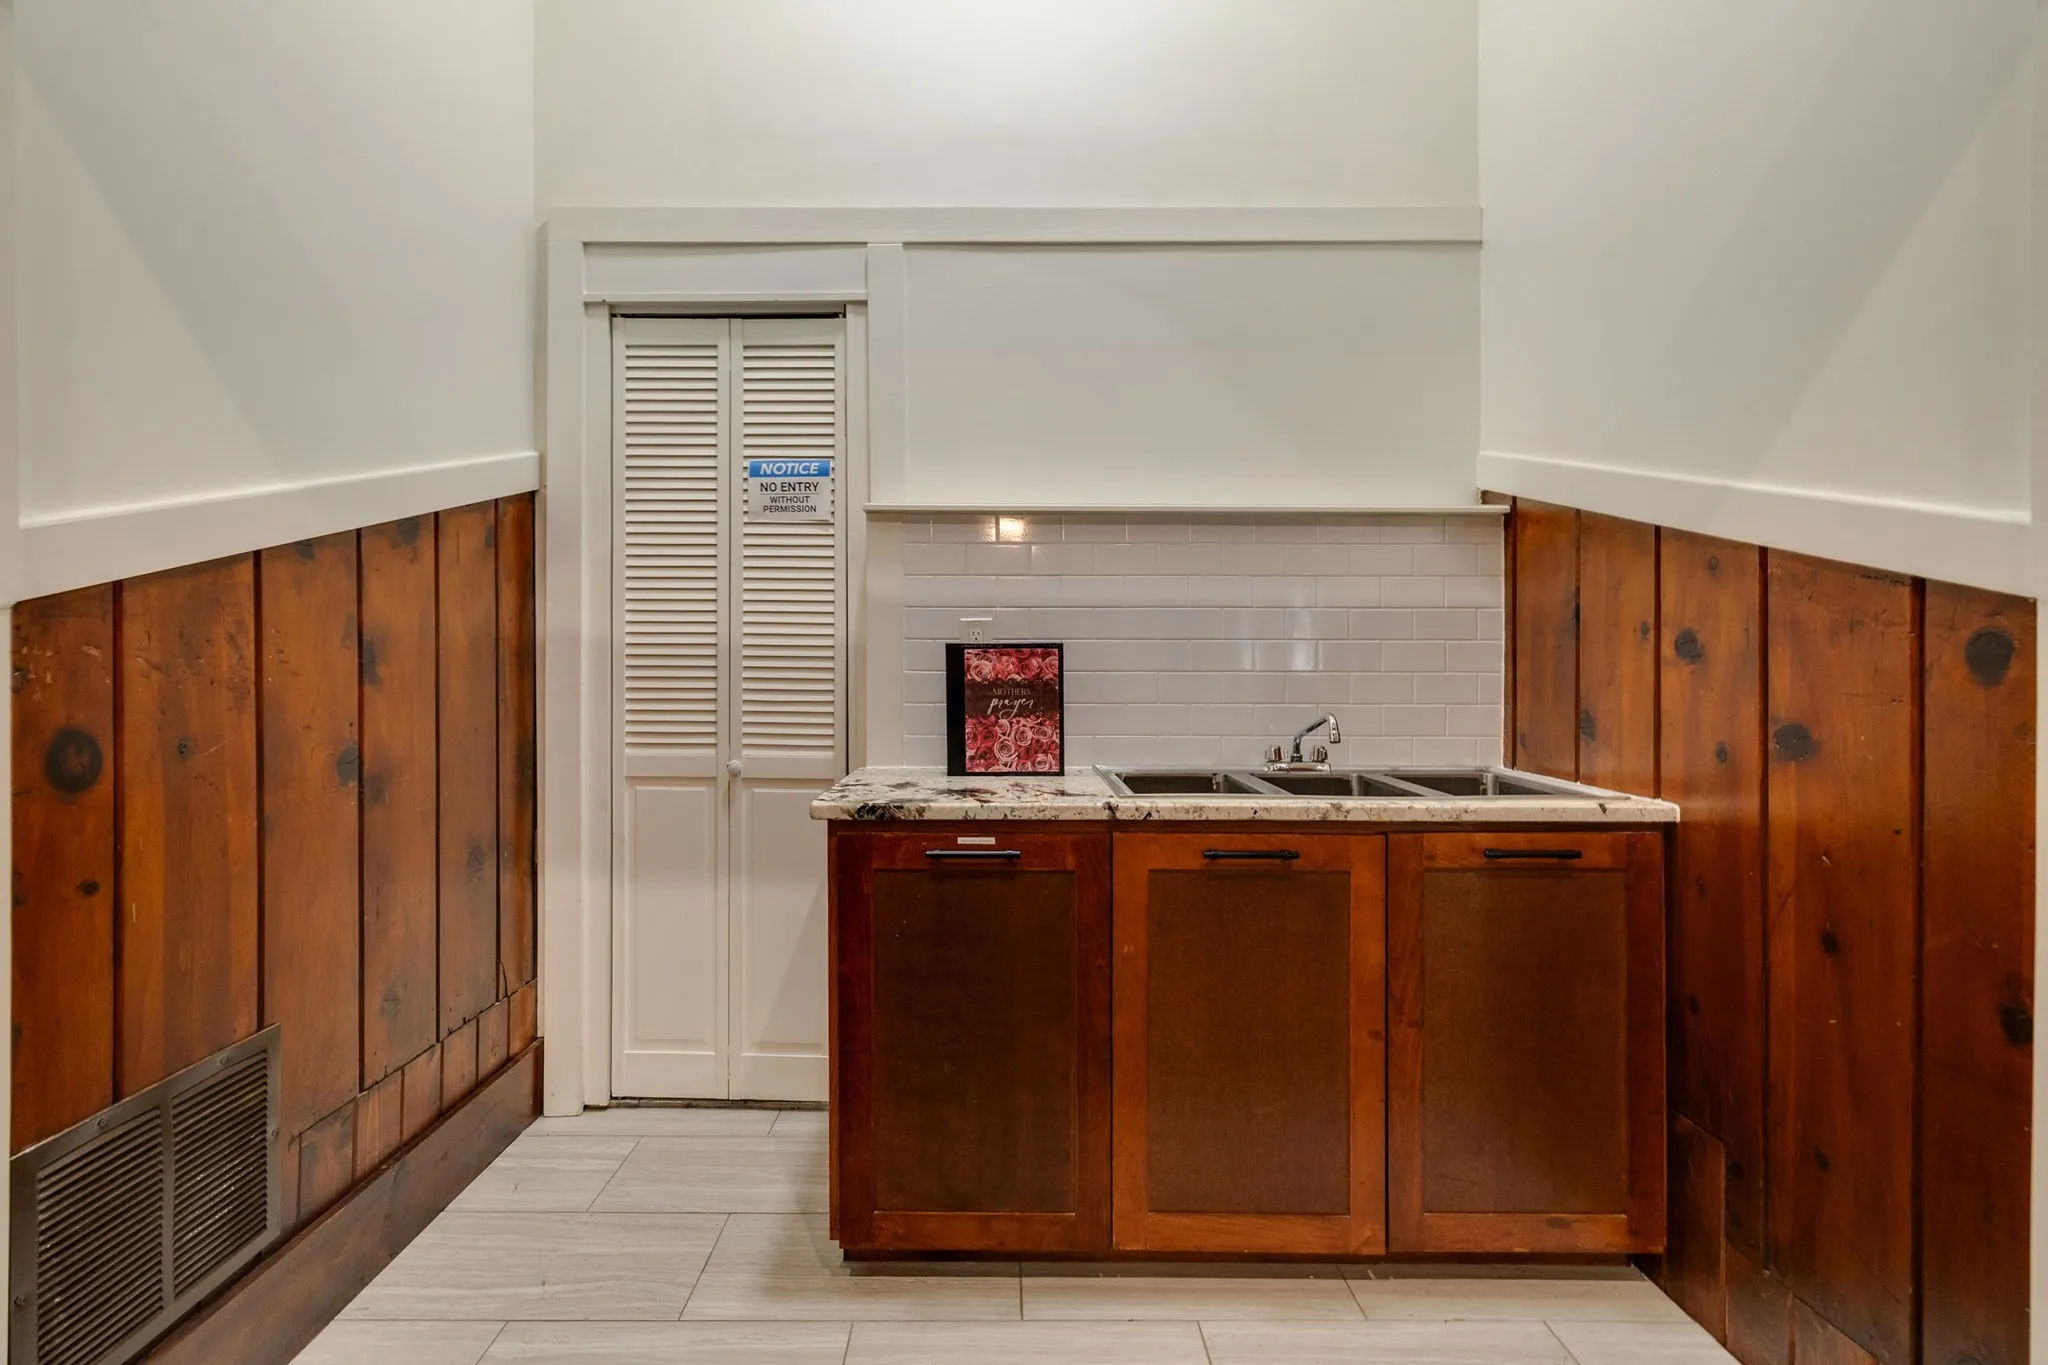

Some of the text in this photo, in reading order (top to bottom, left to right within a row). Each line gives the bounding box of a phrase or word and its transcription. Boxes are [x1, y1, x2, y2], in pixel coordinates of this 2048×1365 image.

[760, 462, 819, 475] NOTICE
[760, 482, 819, 492] NO ENTRY
[763, 505, 816, 513] PERMISSION
[992, 688, 1031, 696] MOTHERS
[987, 698, 1034, 720] prayer
